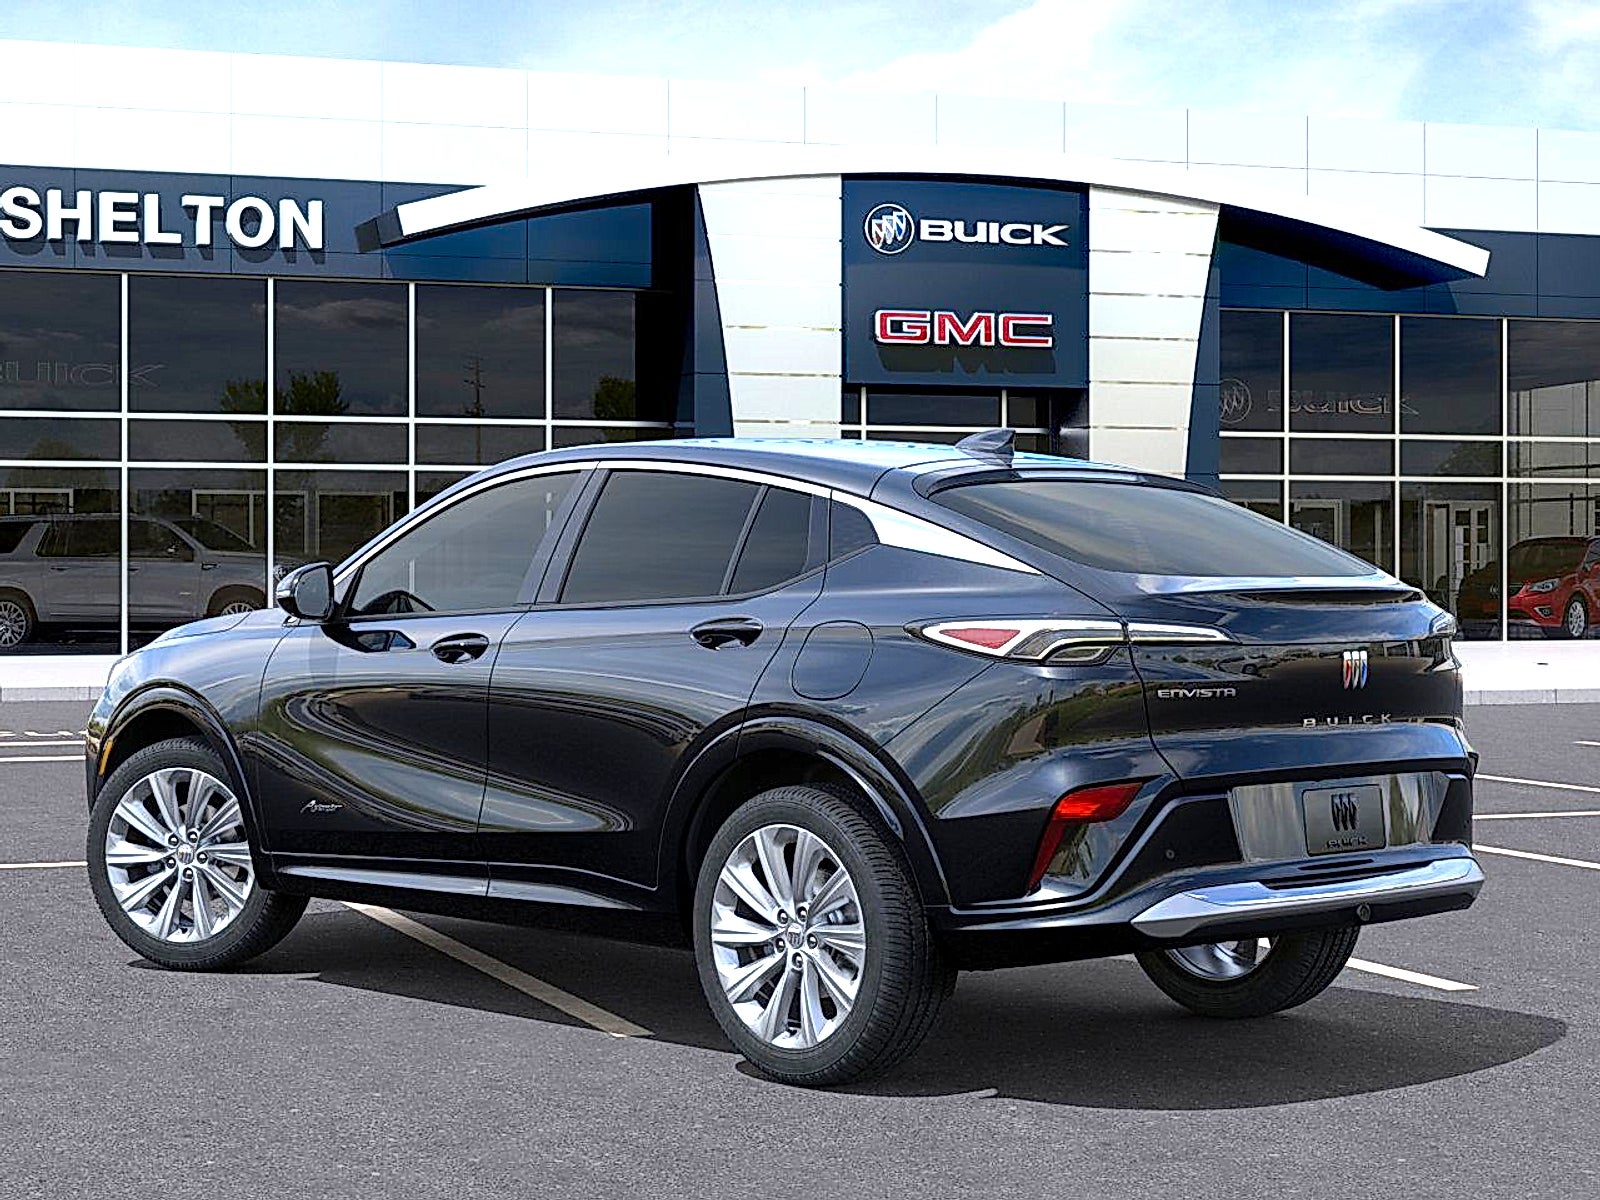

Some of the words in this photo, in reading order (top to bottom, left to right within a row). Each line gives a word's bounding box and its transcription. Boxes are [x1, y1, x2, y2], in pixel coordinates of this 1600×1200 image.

[0, 187, 323, 249] SHELTON
[919, 219, 1069, 246] BUICK
[875, 309, 1053, 347] GMC
[1157, 687, 1237, 699] ENVISTA
[1303, 713, 1392, 728] BUICK
